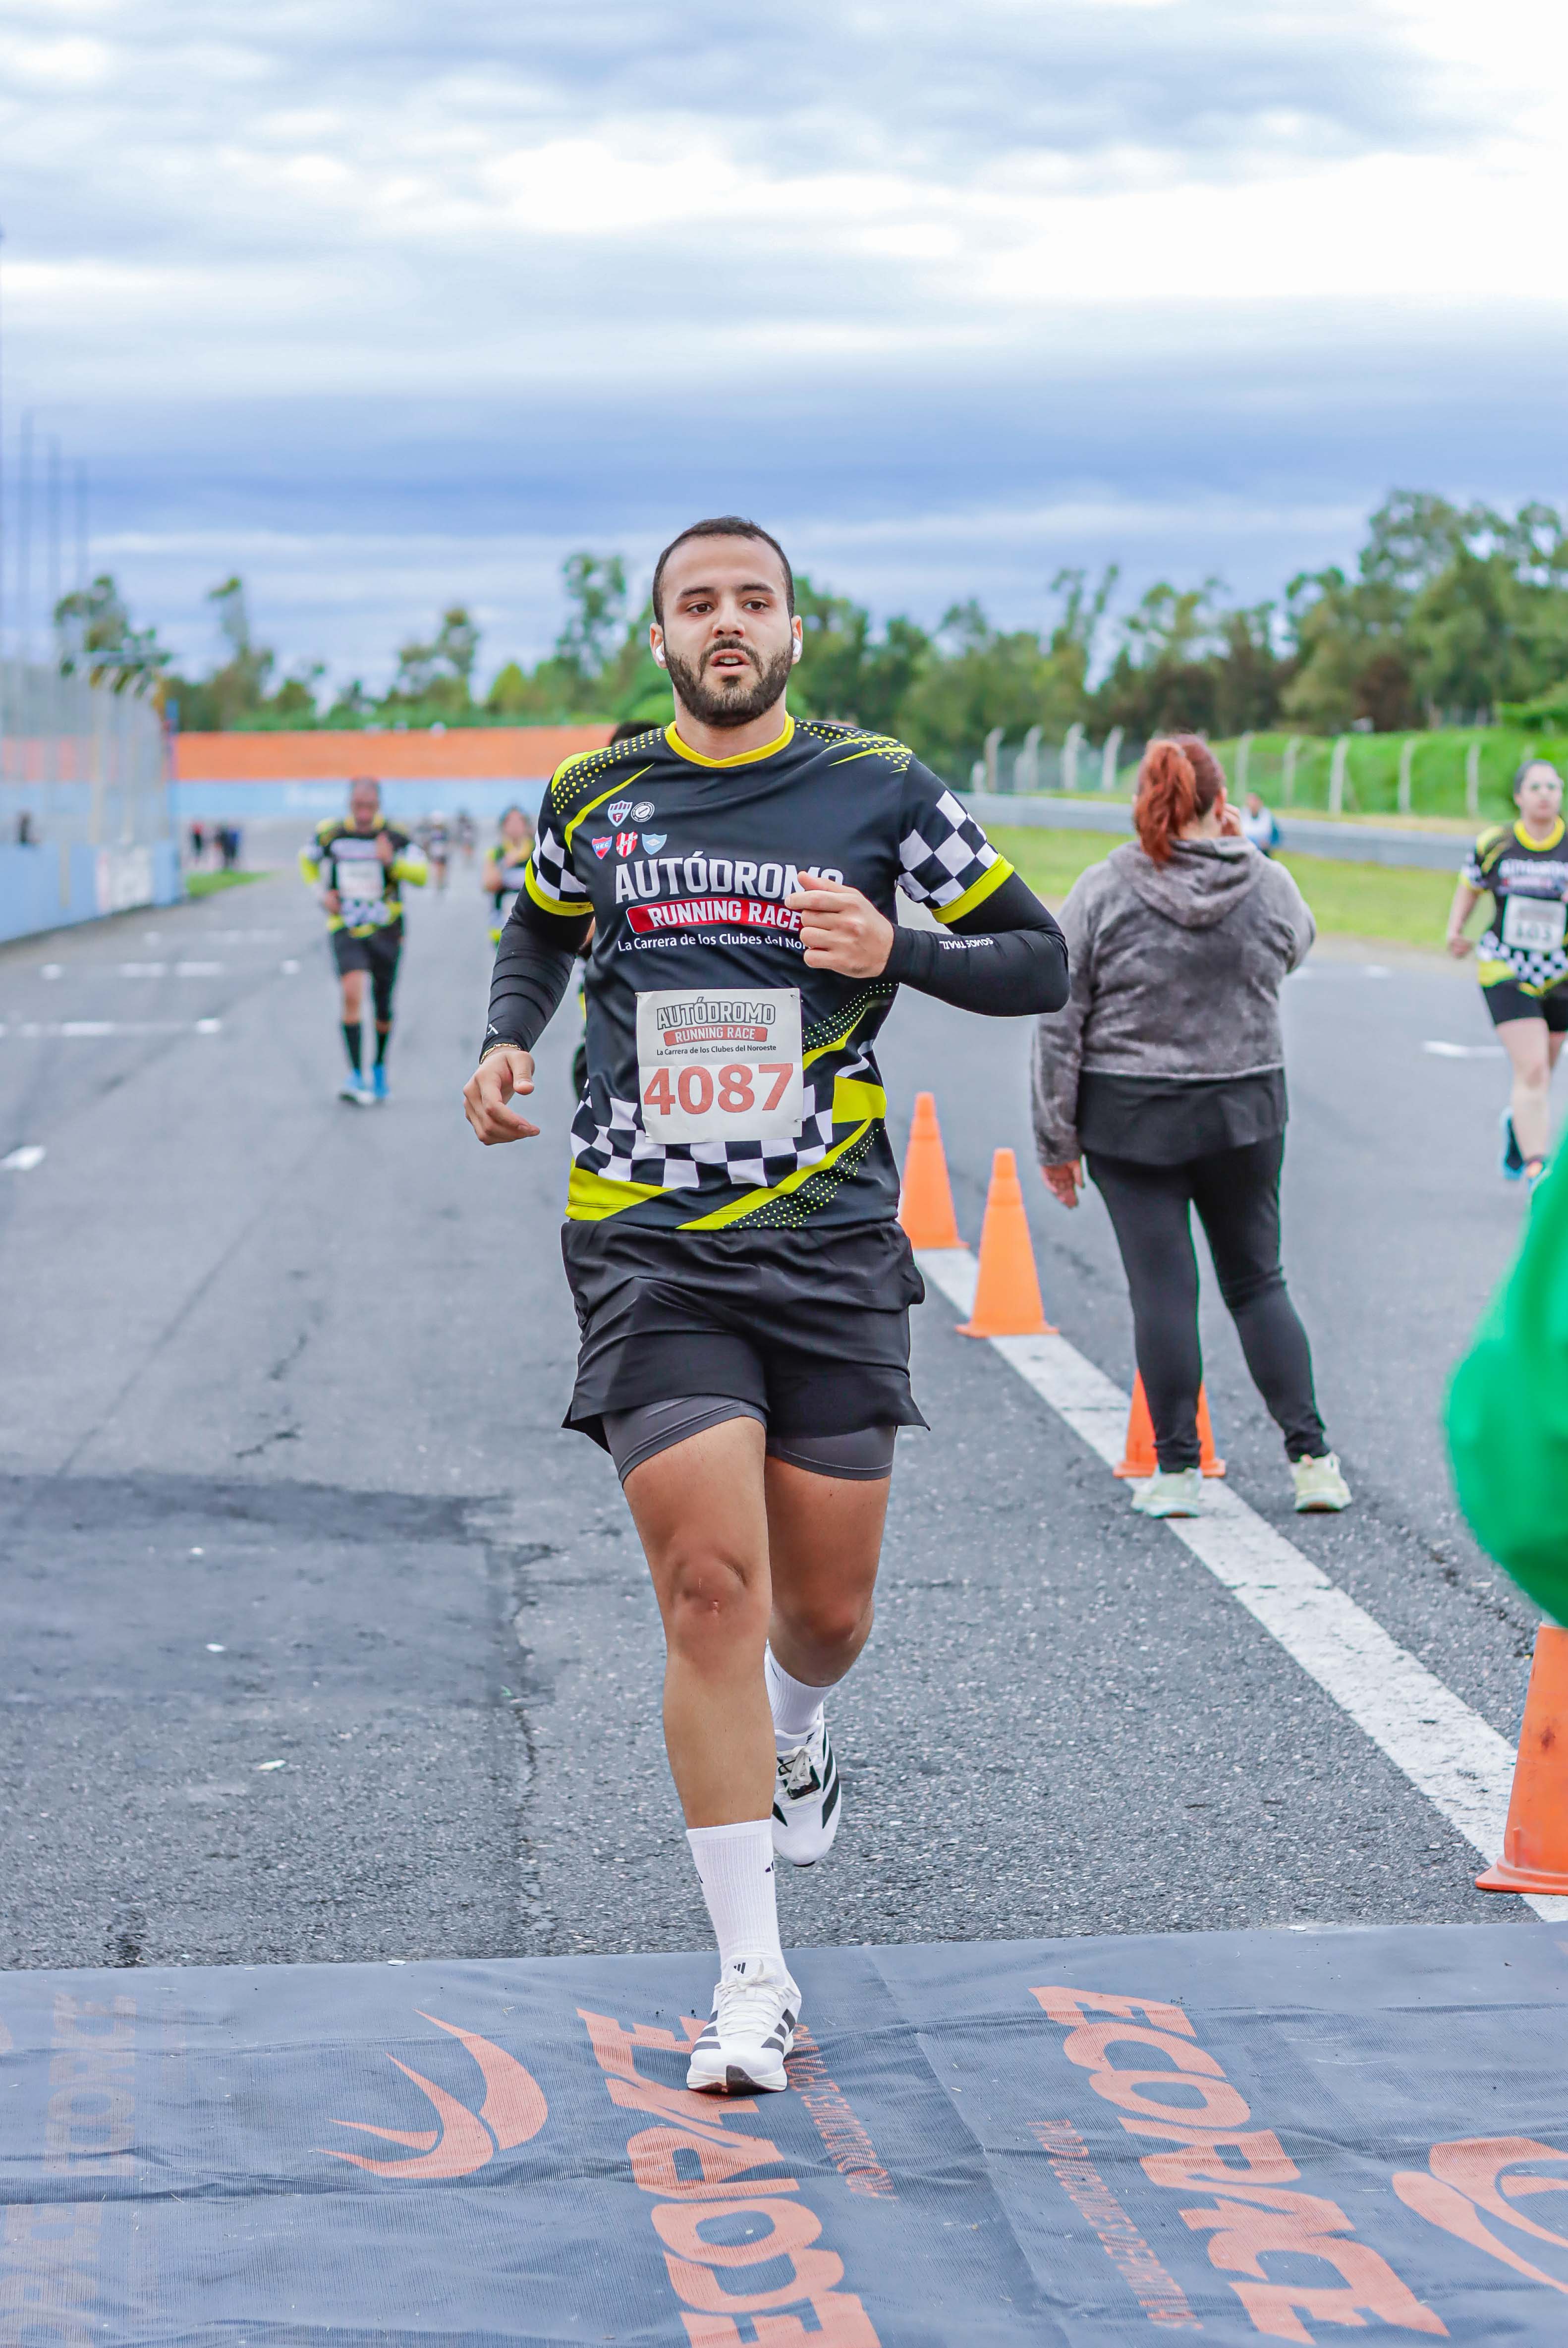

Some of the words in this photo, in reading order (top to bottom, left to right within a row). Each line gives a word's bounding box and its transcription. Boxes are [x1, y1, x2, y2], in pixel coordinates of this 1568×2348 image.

[647, 900, 742, 927] RUNNING
[748, 902, 802, 932] RACE
[617, 940, 632, 951] La
[634, 937, 677, 950] Carrera
[680, 934, 696, 946] de
[698, 933, 717, 945] los
[719, 933, 762, 945] Clubes
[765, 936, 782, 947] del
[657, 997, 776, 1031] AUTÓDROMO
[674, 1027, 724, 1043] RUNNING
[727, 1026, 756, 1040] RACE
[644, 1063, 793, 1116] 4087
[1028, 1985, 1450, 2346] ECORACE
